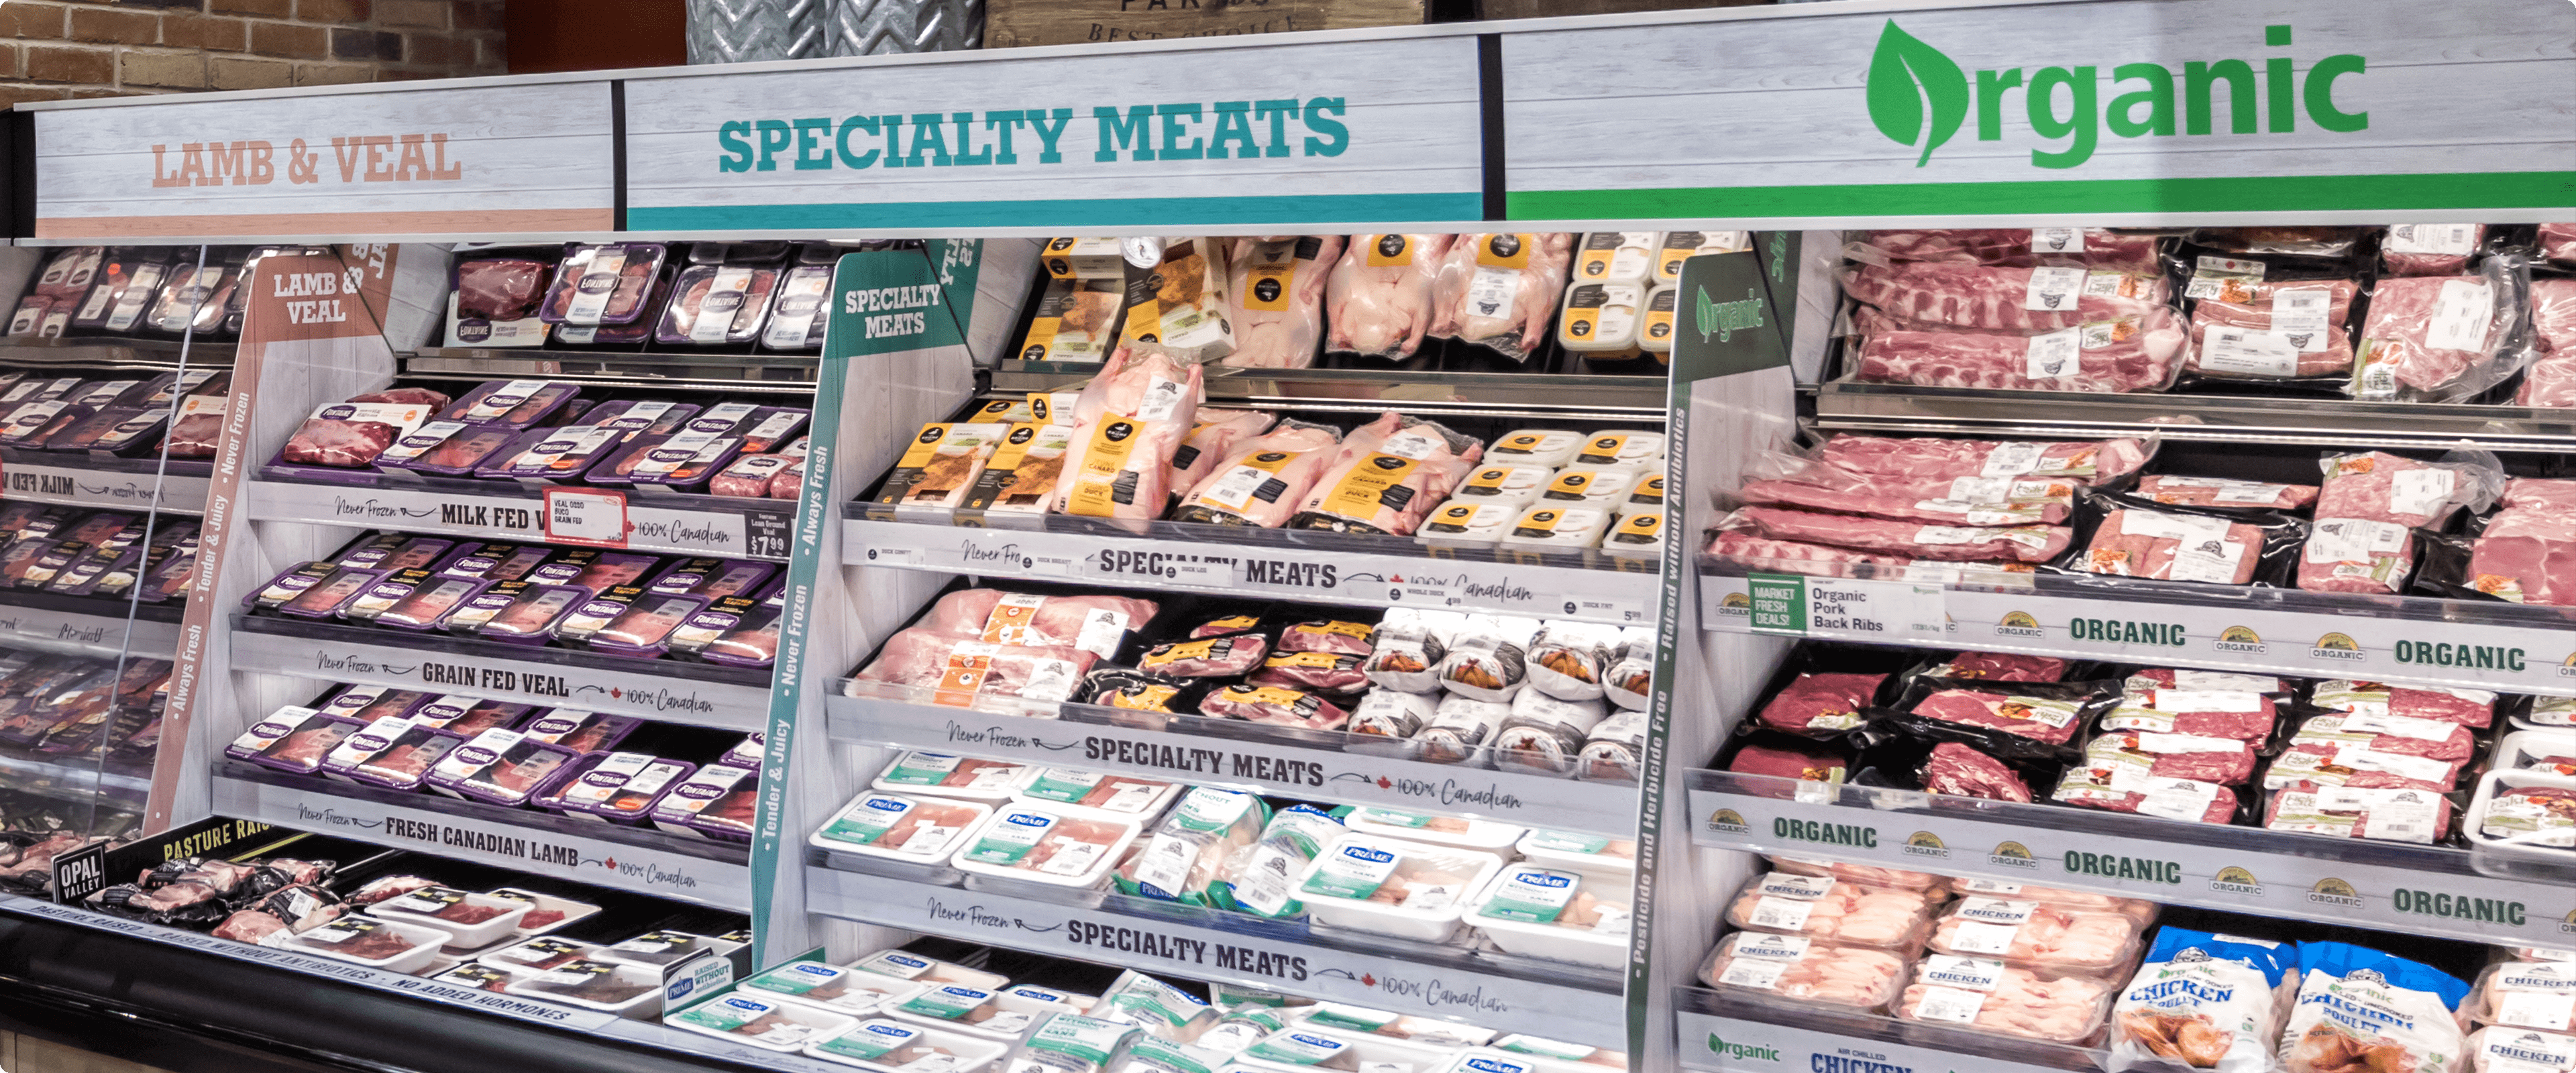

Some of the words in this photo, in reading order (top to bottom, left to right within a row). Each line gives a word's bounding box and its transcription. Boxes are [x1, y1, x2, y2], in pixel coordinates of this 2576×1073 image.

[718, 107, 1073, 174] SPECIALTY
[1093, 97, 1350, 163] MEATS
[152, 142, 274, 188] LAMB
[288, 137, 319, 184] &
[332, 134, 462, 183] VEAL
[274, 272, 337, 297] LAMB
[341, 271, 358, 294] &
[286, 299, 346, 325] VEAL
[845, 284, 941, 314] SPECIALTY
[865, 312, 925, 339] MEATS
[228, 392, 250, 435] Frozen
[221, 436, 241, 475] Never
[808, 445, 828, 489] Fresh
[1668, 407, 1686, 508] Antibiotics
[208, 494, 229, 532] Juicy
[335, 495, 364, 516] Never
[366, 499, 396, 518] Frozen
[441, 503, 488, 526] MILK
[493, 507, 529, 529] FED
[802, 491, 822, 547] Always
[205, 534, 220, 547] &
[639, 521, 667, 539] 100%
[671, 519, 730, 545] Canadian
[1667, 510, 1681, 581] without
[961, 539, 1000, 561] Never
[1002, 543, 1020, 565] Fro
[196, 548, 217, 592] Tender
[1245, 559, 1338, 589] MEATS
[1754, 586, 1795, 600] MARKET
[1754, 600, 1788, 613] FRESH
[1812, 587, 1867, 603] Organic
[788, 584, 808, 637] Frozen
[1755, 614, 1790, 626] DEALS!
[1813, 602, 1846, 615] Pork
[1813, 616, 1849, 630] Back
[1852, 618, 1884, 632] Ribs
[1997, 627, 2043, 638] ORGANIC
[2070, 616, 2186, 646] ORGANIC
[182, 624, 202, 662] Fresh
[2216, 642, 2266, 653] ORGANIC
[2312, 648, 2365, 661] ORGANIC
[2395, 639, 2526, 673] ORGANIC
[317, 650, 345, 671] Never
[345, 655, 375, 675] Frozen
[782, 639, 800, 688] Never
[172, 663, 195, 712] Always
[422, 661, 476, 688] GRAIN
[480, 667, 517, 693] FED
[521, 673, 570, 697] VEAL
[626, 688, 654, 706] 100%
[656, 686, 714, 714] Canadian
[1652, 689, 1668, 732] Free
[776, 718, 792, 765] Juicy
[946, 719, 985, 744] Never
[986, 726, 1027, 750] Frozen
[768, 767, 783, 782] &
[1085, 736, 1224, 776] SPECIALTY
[1232, 752, 1325, 789] MEATS
[1397, 779, 1436, 797] 100%
[1440, 778, 1523, 809] Canadian
[1642, 736, 1663, 830] Herbicide
[298, 802, 325, 823] Never
[325, 806, 351, 827] Frozen
[762, 785, 782, 840] Tender
[869, 799, 905, 811] PRIME
[1010, 815, 1049, 827] PRIME
[1708, 822, 1748, 834] ORGANIC
[1773, 816, 1878, 848] ORGANIC
[164, 823, 231, 862] PASTURE
[386, 816, 439, 844] FRESH
[442, 826, 526, 860] CANADIAN
[530, 840, 580, 868] LAMB
[1345, 847, 1393, 863] PRIME
[1642, 832, 1656, 871] and
[1904, 846, 1948, 858] ORGANIC
[61, 856, 101, 888] OPAL
[619, 861, 645, 878] 100%
[645, 862, 698, 889] Canadian
[1990, 856, 2037, 868] ORGANIC
[2064, 850, 2182, 885] ORGANIC
[64, 877, 101, 899] VALLEY
[1517, 872, 1569, 887] PRIME
[1764, 884, 1824, 897] CHICKEN
[2212, 882, 2262, 895] ORGANIC
[926, 896, 967, 921] Never
[967, 904, 1009, 929] Frozen
[1963, 908, 2024, 920] CHICKEN
[2309, 894, 2362, 907] ORGANIC
[2394, 888, 2526, 926] ORGANIC
[1633, 874, 1652, 964] Pesticide
[31, 905, 94, 923] PASTURE
[93, 915, 144, 932] RAISED
[211, 940, 278, 960] WITHOUT
[278, 951, 376, 980] ANTIBIOTICS
[392, 977, 421, 989] NO
[421, 982, 478, 1002] ADDED
[474, 995, 572, 1021] HORMONES
[1067, 919, 1208, 966] SPECIALTY
[1216, 944, 1309, 982] MEATS
[1739, 946, 1799, 957] CHICKEN
[694, 961, 719, 976] RAISED
[694, 964, 731, 986] WITHOUT
[1929, 971, 1992, 984] CHICKEN
[669, 981, 693, 999] PRIME
[694, 976, 727, 994] antibiotics
[1381, 976, 1421, 997] 100%
[1426, 979, 1509, 1013] Canadian
[2129, 979, 2234, 1003] CHICKEN
[2489, 1043, 2567, 1064] CHICKEN
